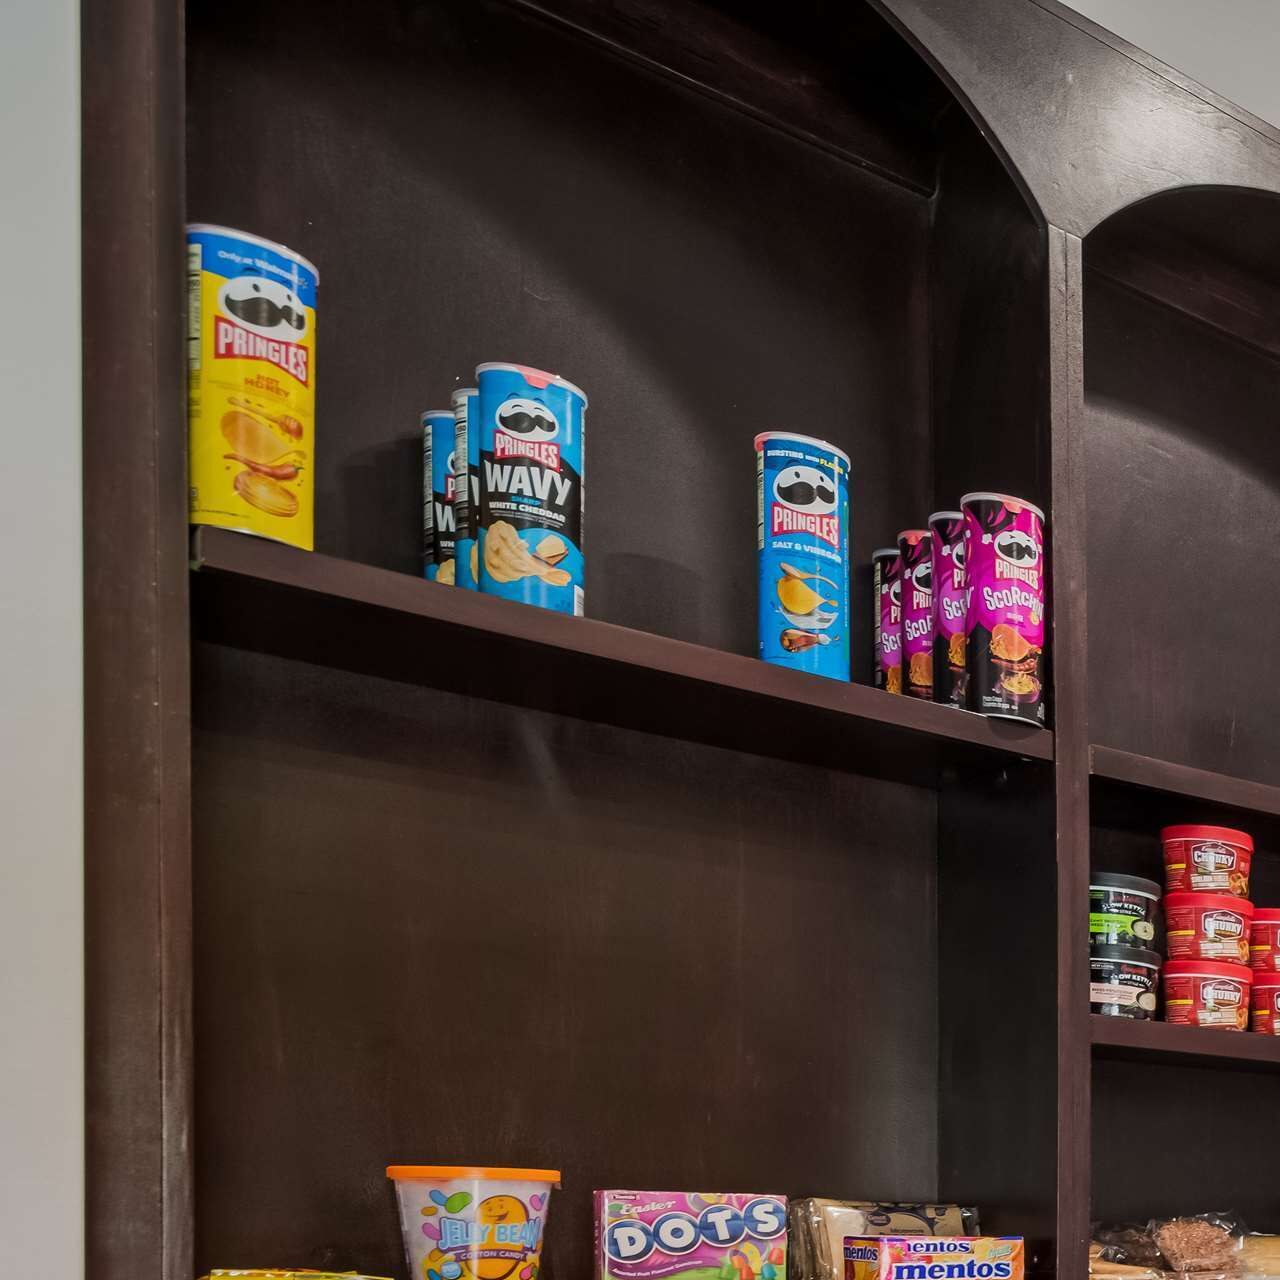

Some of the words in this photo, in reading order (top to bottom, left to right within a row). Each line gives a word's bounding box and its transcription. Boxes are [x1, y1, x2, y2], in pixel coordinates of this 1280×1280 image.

[218, 322, 307, 382] PRINGLES
[495, 433, 559, 468] PRINGLES
[483, 460, 572, 506] WAVY
[489, 501, 518, 511] WHITE
[519, 504, 566, 523] CHEDDAR
[773, 506, 839, 547] PRINGLES
[772, 540, 792, 549] SALT
[995, 561, 1039, 590] PRINGLES
[1194, 851, 1234, 866] CHUNKY
[620, 1200, 676, 1214] Easter
[438, 1217, 490, 1249] JELLY
[496, 1218, 540, 1249] BEAN
[613, 1203, 779, 1257] DOTS
[499, 1250, 524, 1260] CANDY
[844, 1246, 878, 1261] mentos
[894, 1260, 1012, 1280] mentos
